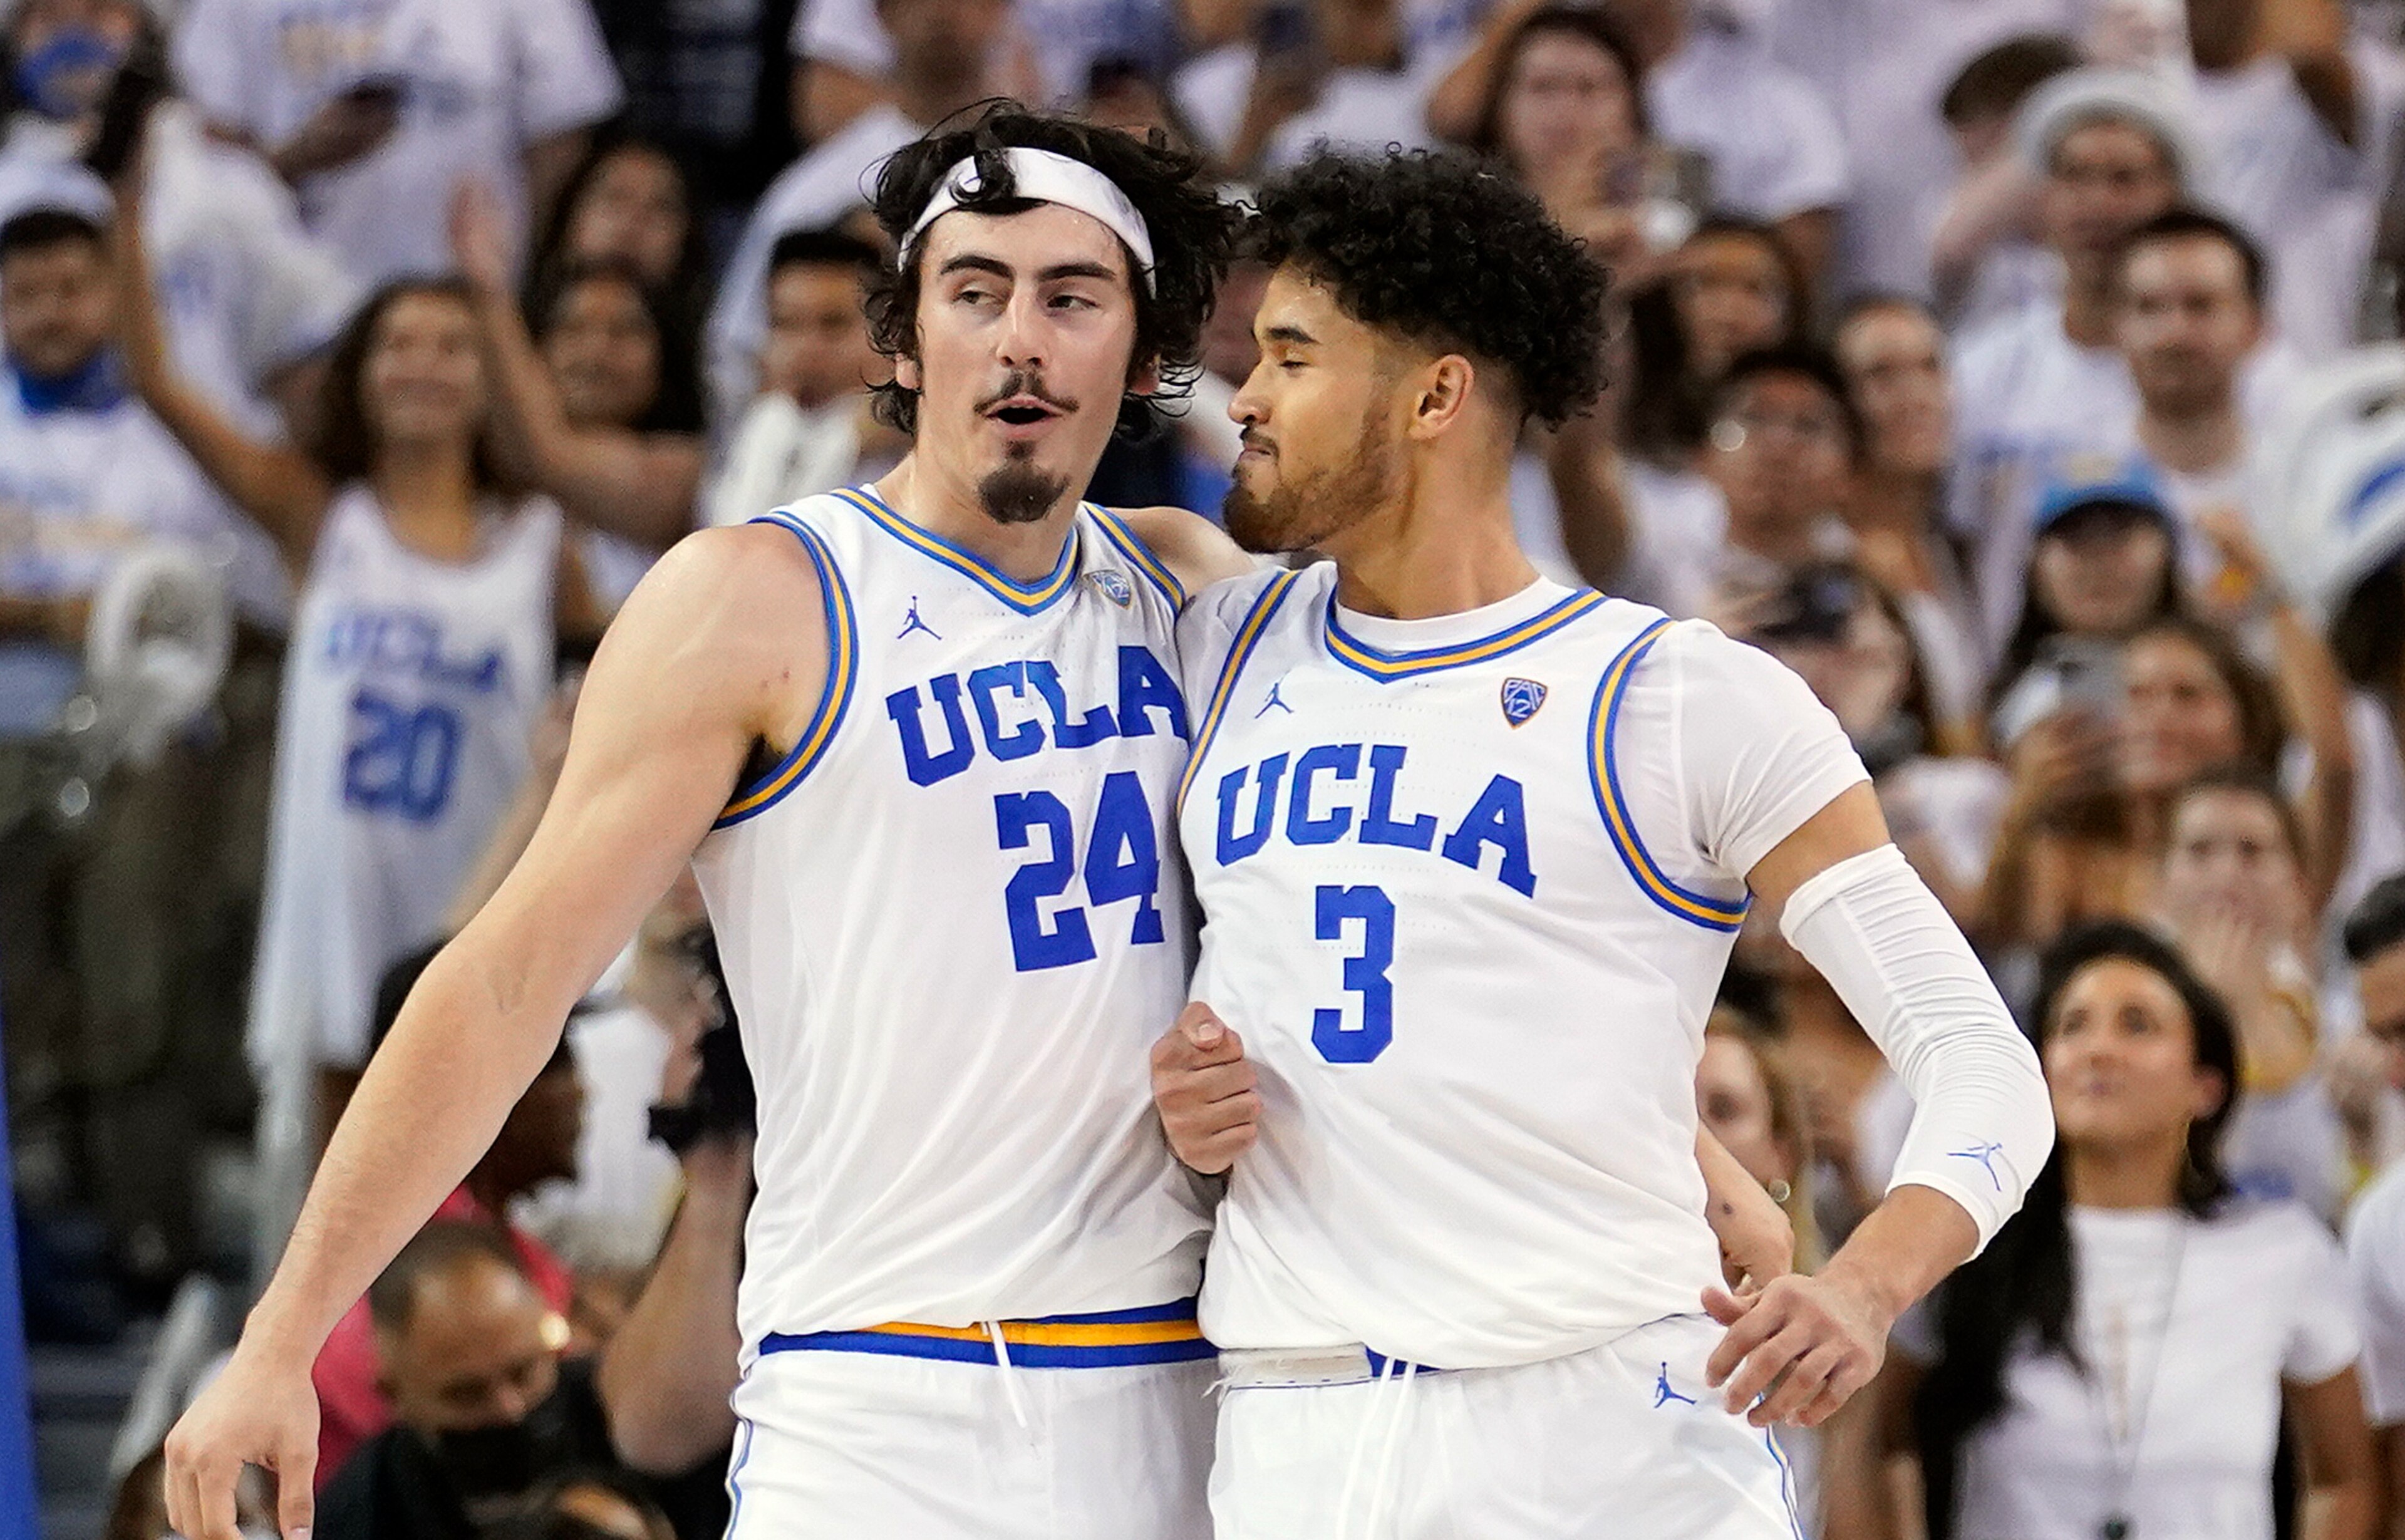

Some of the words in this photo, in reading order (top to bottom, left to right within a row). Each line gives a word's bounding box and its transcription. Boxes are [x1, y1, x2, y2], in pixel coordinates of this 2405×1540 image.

[343, 688, 463, 820] 20
[886, 646, 1189, 787] UCLA
[1504, 680, 1546, 710] PAC
[1506, 698, 1531, 718] 12
[994, 771, 1164, 972] 24
[1216, 743, 1538, 898] UCLA
[1311, 885, 1395, 1063] 3
